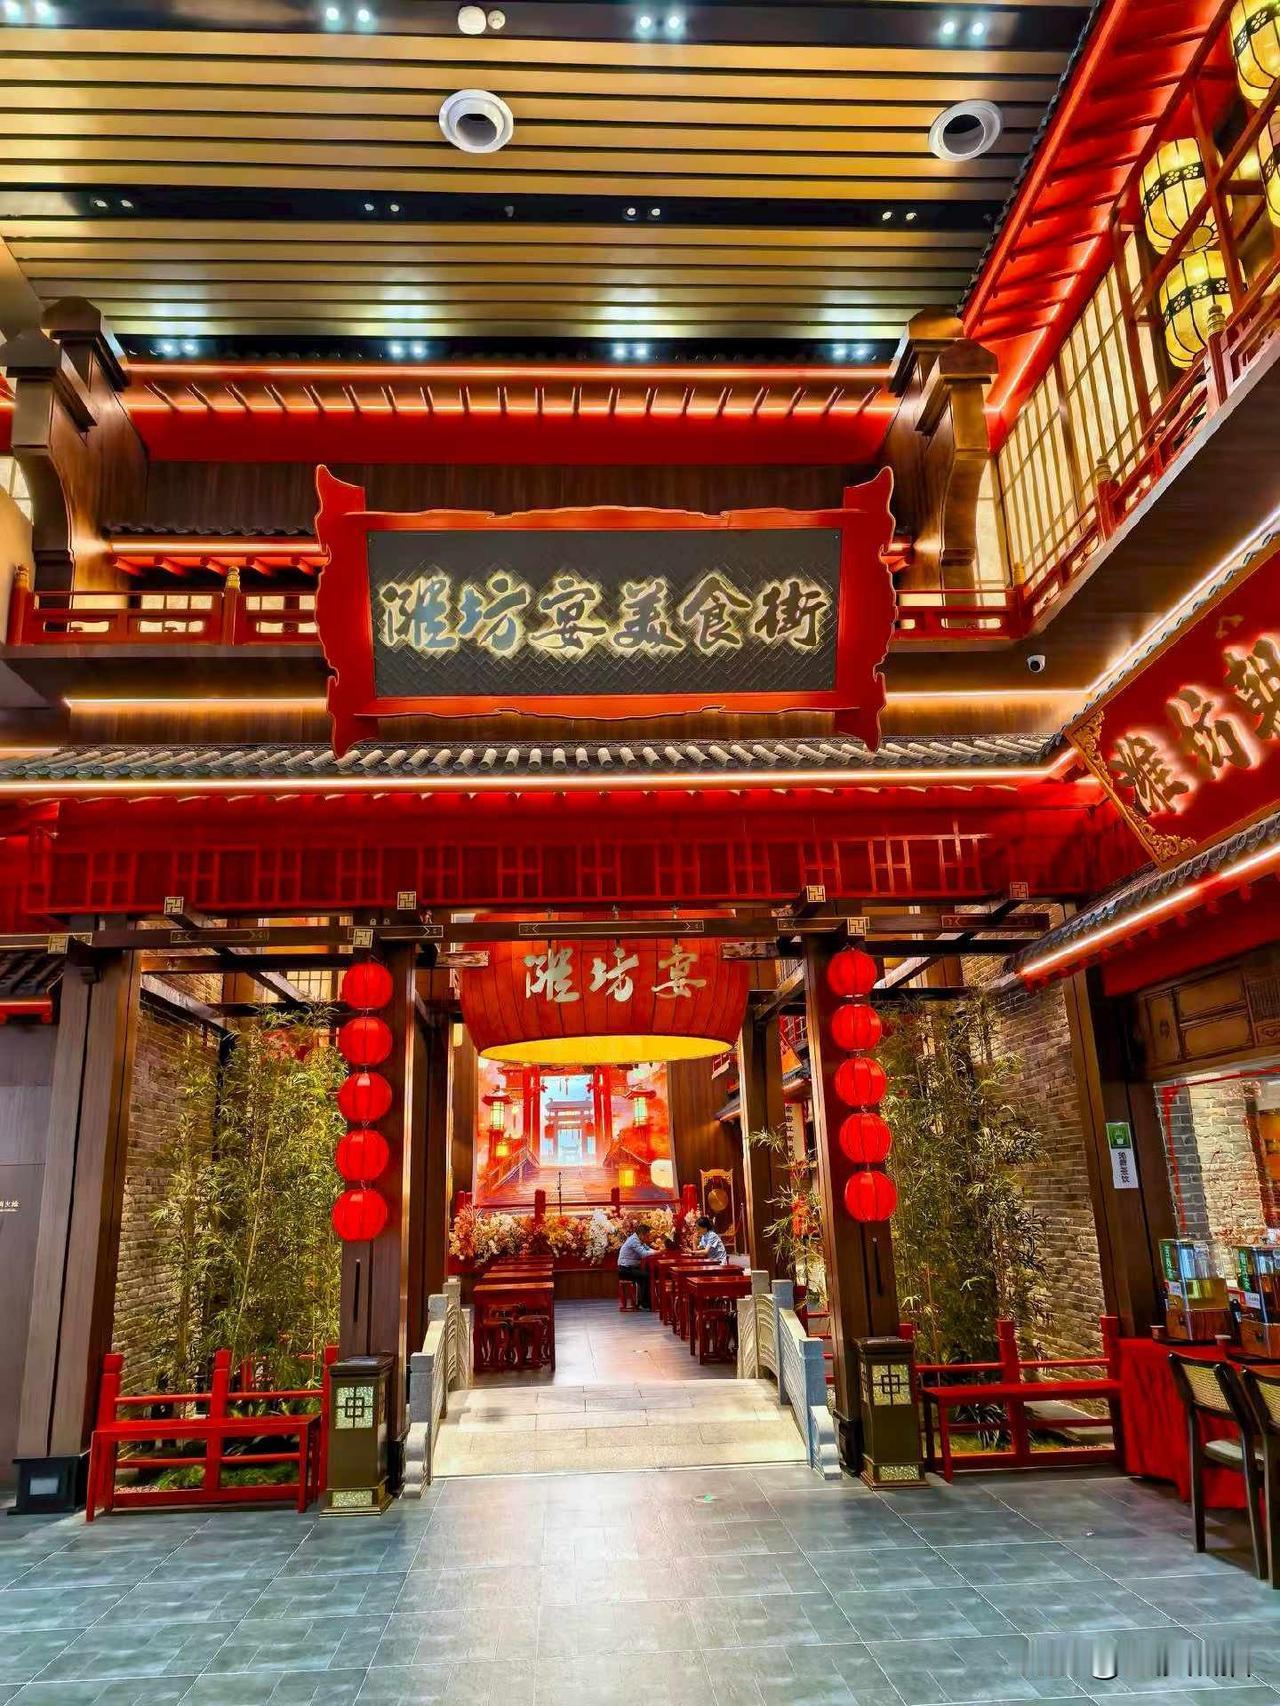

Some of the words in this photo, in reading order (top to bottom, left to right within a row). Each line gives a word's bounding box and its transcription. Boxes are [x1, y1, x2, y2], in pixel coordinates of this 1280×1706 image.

[380, 576, 829, 655] 潍坊宴美食街
[523, 945, 707, 1002] 潍坊宴
